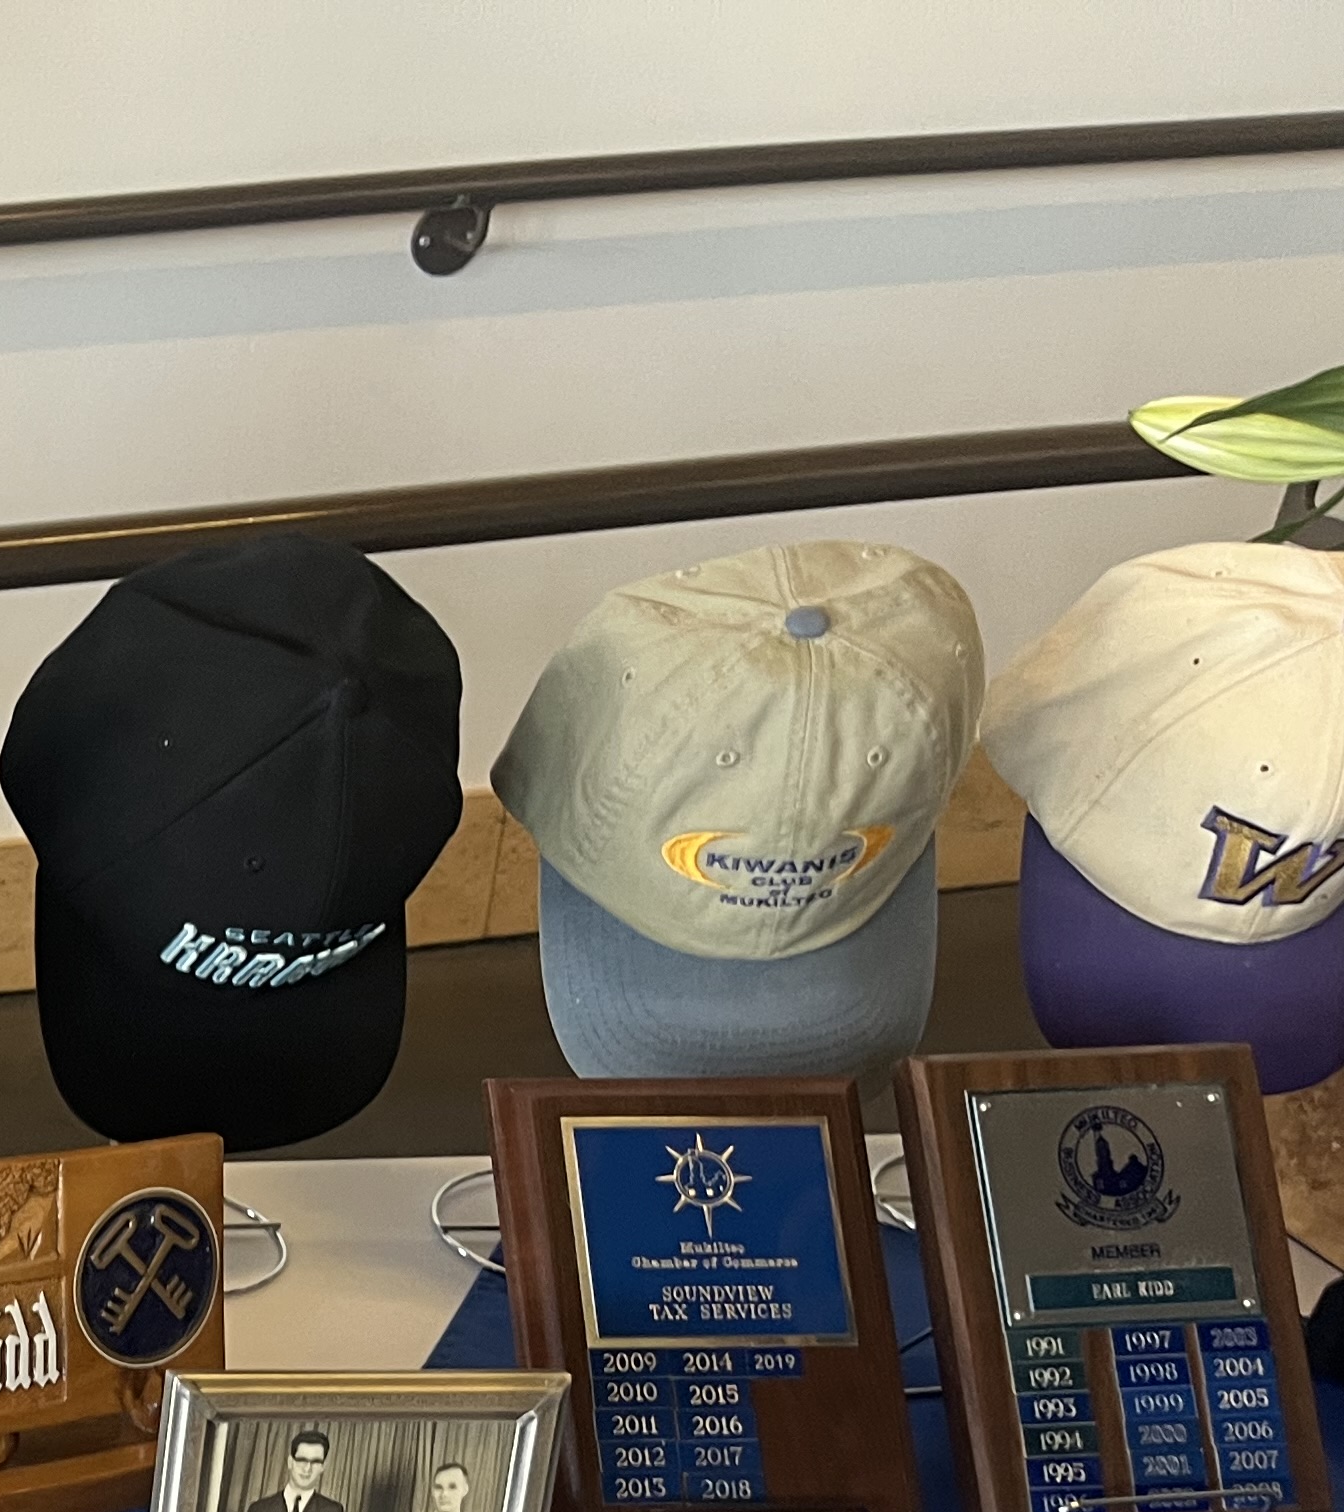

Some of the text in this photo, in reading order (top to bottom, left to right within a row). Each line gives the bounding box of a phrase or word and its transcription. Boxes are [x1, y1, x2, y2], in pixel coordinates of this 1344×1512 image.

[706, 846, 859, 873] KIWANIS
[751, 876, 813, 887] CLUB
[720, 888, 834, 907] MUKILTEO
[160, 922, 386, 987] KRA
[1091, 1243, 1161, 1261] MEMBER
[631, 1256, 698, 1269] Chamber
[722, 1256, 799, 1270] Commerce
[662, 1285, 774, 1302] SOUNDVIEW
[1092, 1280, 1174, 1300] EARL KIDD
[648, 1302, 792, 1321] TAX SERVICES
[1026, 1337, 1065, 1358] 1991
[1125, 1330, 1172, 1351] 1997
[603, 1352, 657, 1373] 2009
[683, 1352, 733, 1373] 2014
[755, 1353, 795, 1371] 2019
[1129, 1362, 1178, 1383] 1998
[1213, 1357, 1265, 1378] 2004
[1029, 1367, 1074, 1387] 1992
[607, 1381, 658, 1402] 2010
[689, 1384, 739, 1405] 2015
[1217, 1388, 1269, 1410] 2005
[1033, 1399, 1077, 1419] 1993
[1134, 1393, 1184, 1414] 1999
[612, 1415, 659, 1435] 2011
[692, 1415, 743, 1436] 2016
[1223, 1420, 1273, 1442] 2006
[1040, 1431, 1084, 1451] 1994
[616, 1447, 665, 1467] 2012
[695, 1446, 743, 1467] 2017
[1229, 1449, 1279, 1471] 2007
[1043, 1462, 1086, 1484] 1995
[702, 1479, 752, 1500] 2018
